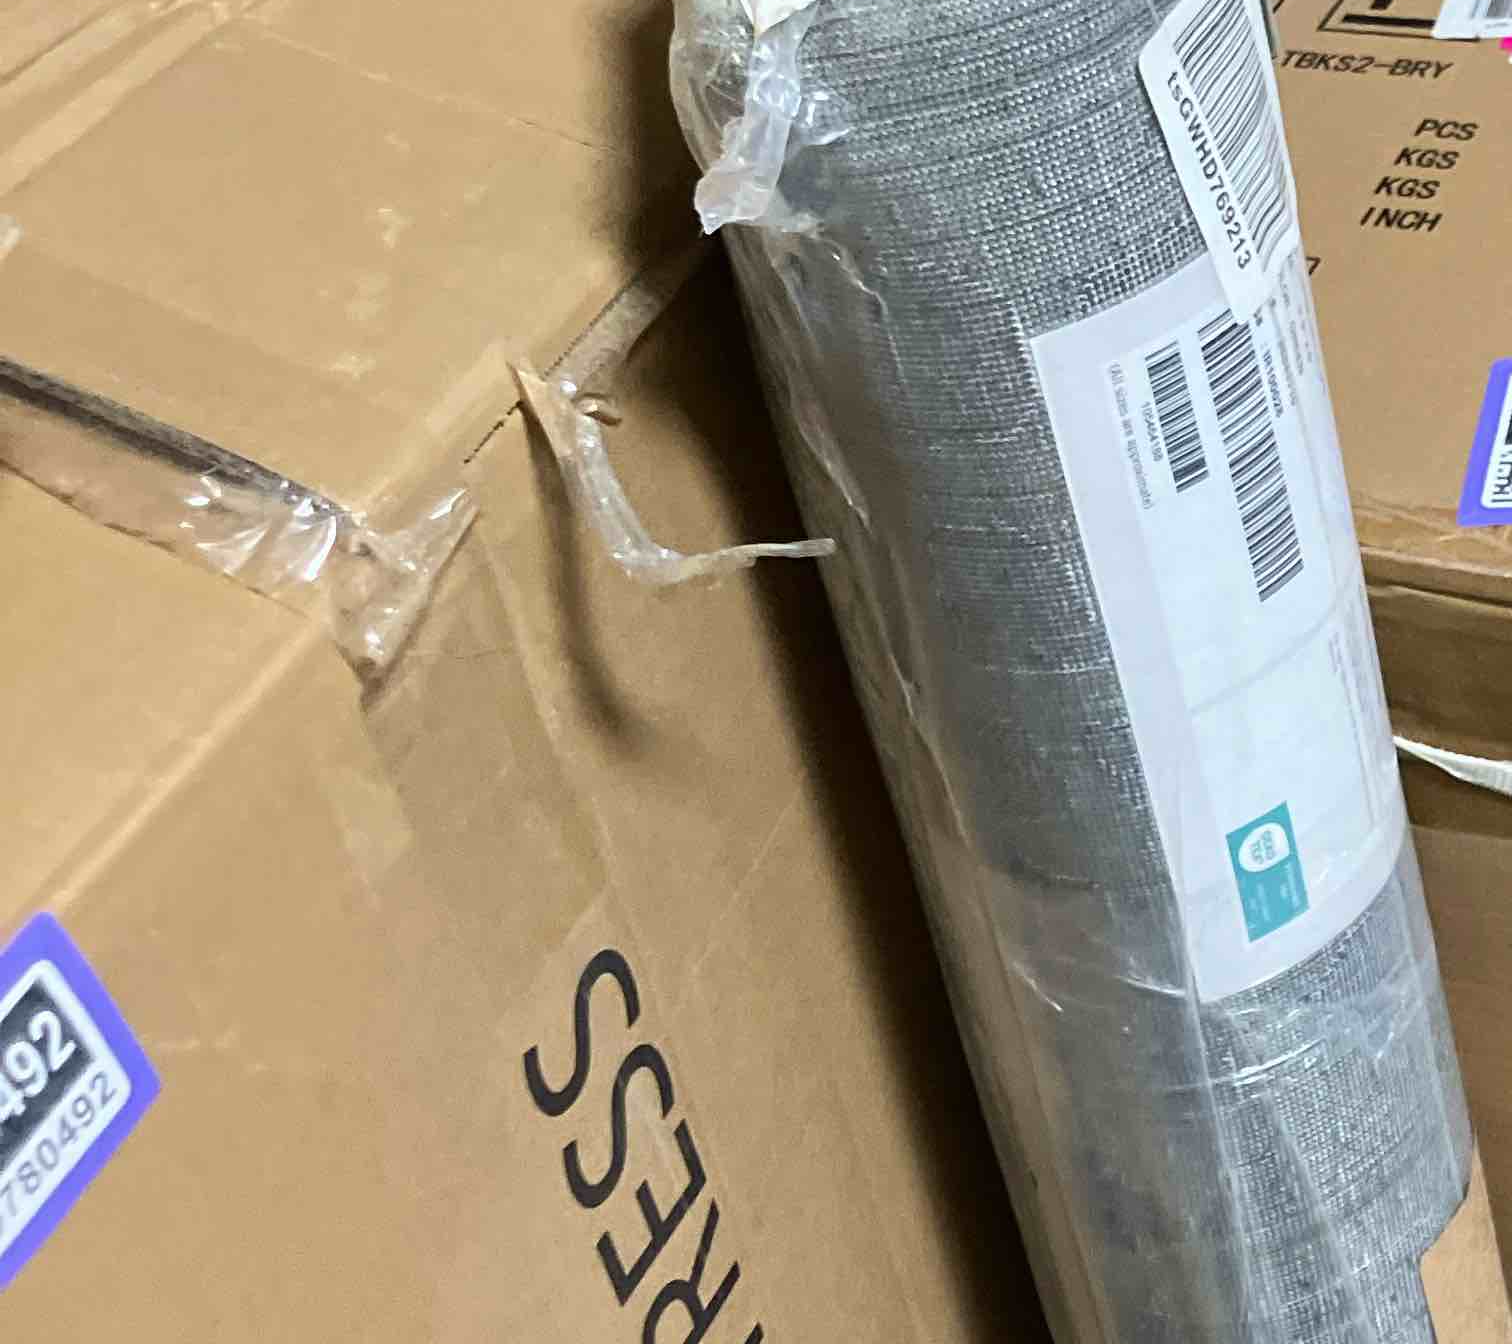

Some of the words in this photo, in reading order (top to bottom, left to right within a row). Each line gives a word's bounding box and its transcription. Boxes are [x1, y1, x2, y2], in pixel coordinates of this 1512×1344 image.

[1414, 118, 1479, 141] PCS
[1167, 69, 1252, 270] tsGWHD769213
[1393, 147, 1460, 170] KGS
[1373, 175, 1441, 200] KGS
[1359, 206, 1443, 232] INCH
